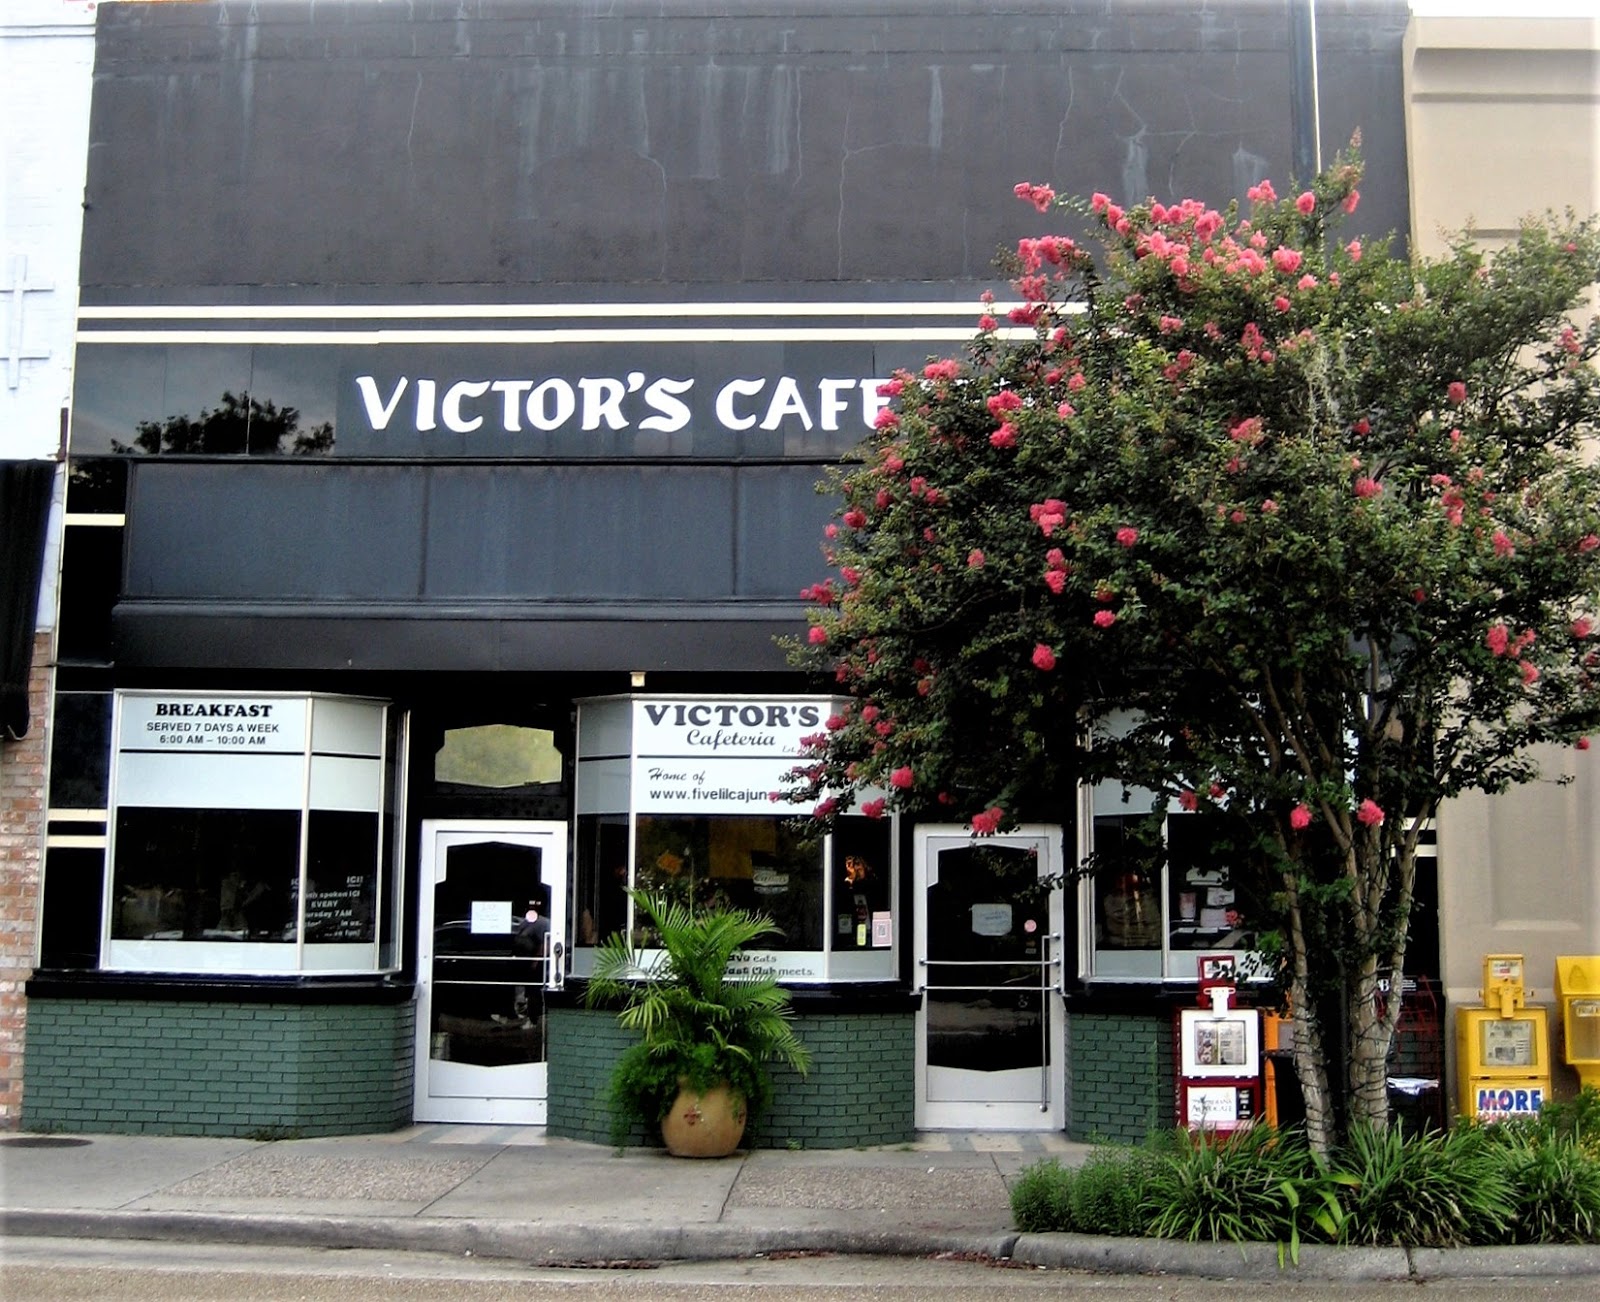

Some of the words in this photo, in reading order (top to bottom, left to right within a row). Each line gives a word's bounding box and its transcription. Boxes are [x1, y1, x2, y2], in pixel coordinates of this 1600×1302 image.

[356, 371, 695, 433] VICTOR'S
[716, 376, 900, 433] CAFE
[156, 703, 273, 717] BREAKFAST
[644, 704, 820, 727] VICTOR'S
[147, 722, 191, 732] SERVED
[194, 723, 201, 732] 7
[204, 723, 234, 732] DAYS
[236, 724, 244, 732] A
[247, 724, 279, 733] WEEK
[159, 735, 183, 744] 6:00
[186, 735, 204, 744] AM
[217, 735, 245, 745] 10:00
[248, 736, 267, 745] AM
[686, 729, 777, 750] Cafeteria
[648, 767, 687, 781] Home
[692, 770, 706, 784] of
[650, 788, 771, 803] www.fivelilcajun
[311, 900, 338, 908] EVERY
[304, 910, 332, 918] ursday
[1478, 1089, 1541, 1112] MORE
